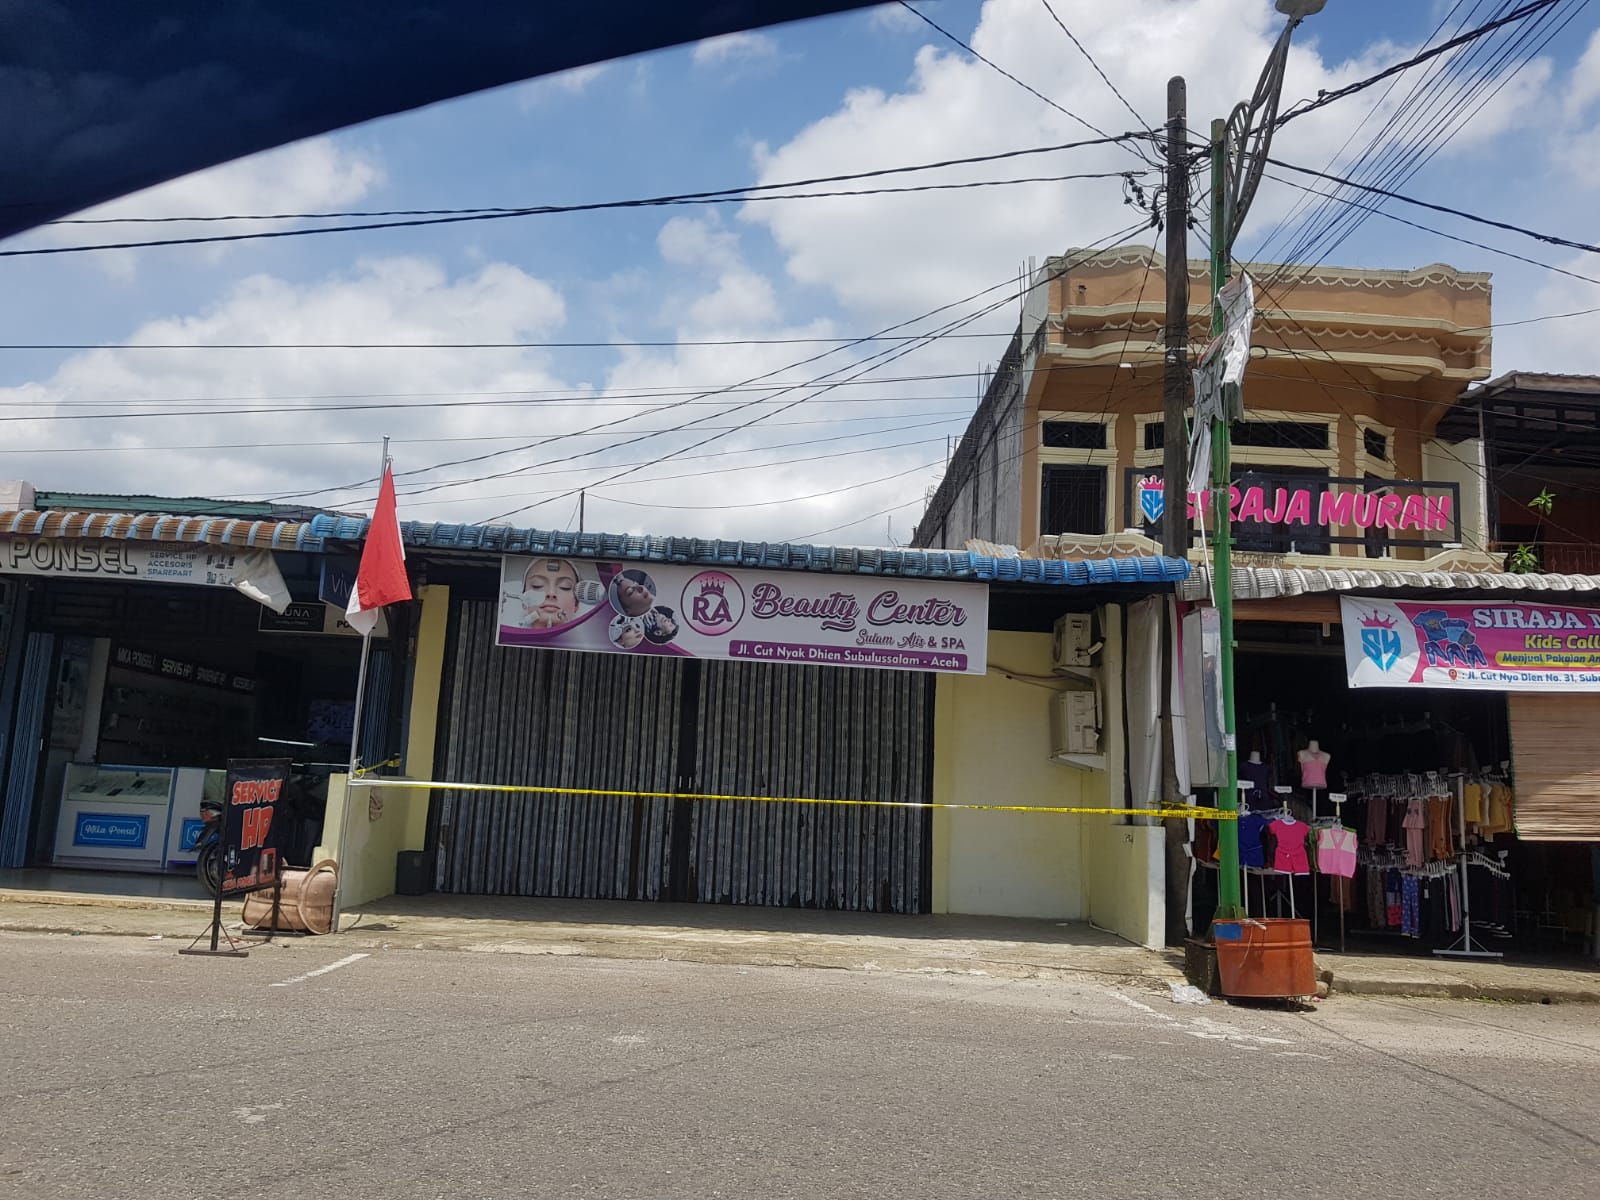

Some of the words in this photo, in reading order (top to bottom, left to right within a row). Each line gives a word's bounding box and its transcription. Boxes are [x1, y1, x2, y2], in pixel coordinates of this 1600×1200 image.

[1318, 490, 1451, 532] MURAH
[9, 538, 137, 574] PONSEL
[147, 560, 193, 569] ACCESORIS
[147, 568, 193, 577] SPAREPART
[692, 596, 733, 626] RA
[752, 583, 861, 632] Beauty
[866, 590, 968, 628] Center
[1472, 607, 1587, 630] SIRAJA
[856, 628, 895, 646] Sulam
[897, 632, 926, 649] Alis
[927, 636, 938, 649] &
[941, 636, 966, 650] SPA
[1524, 633, 1562, 650] Kids
[737, 643, 750, 655] Jl.
[754, 645, 774, 656] Cut
[777, 646, 806, 661] Nyak
[808, 648, 841, 661] Dhien
[844, 650, 920, 666] Subulussalam
[930, 655, 960, 669] Aceh
[1480, 671, 1497, 681] Cut
[240, 805, 274, 851] HP
